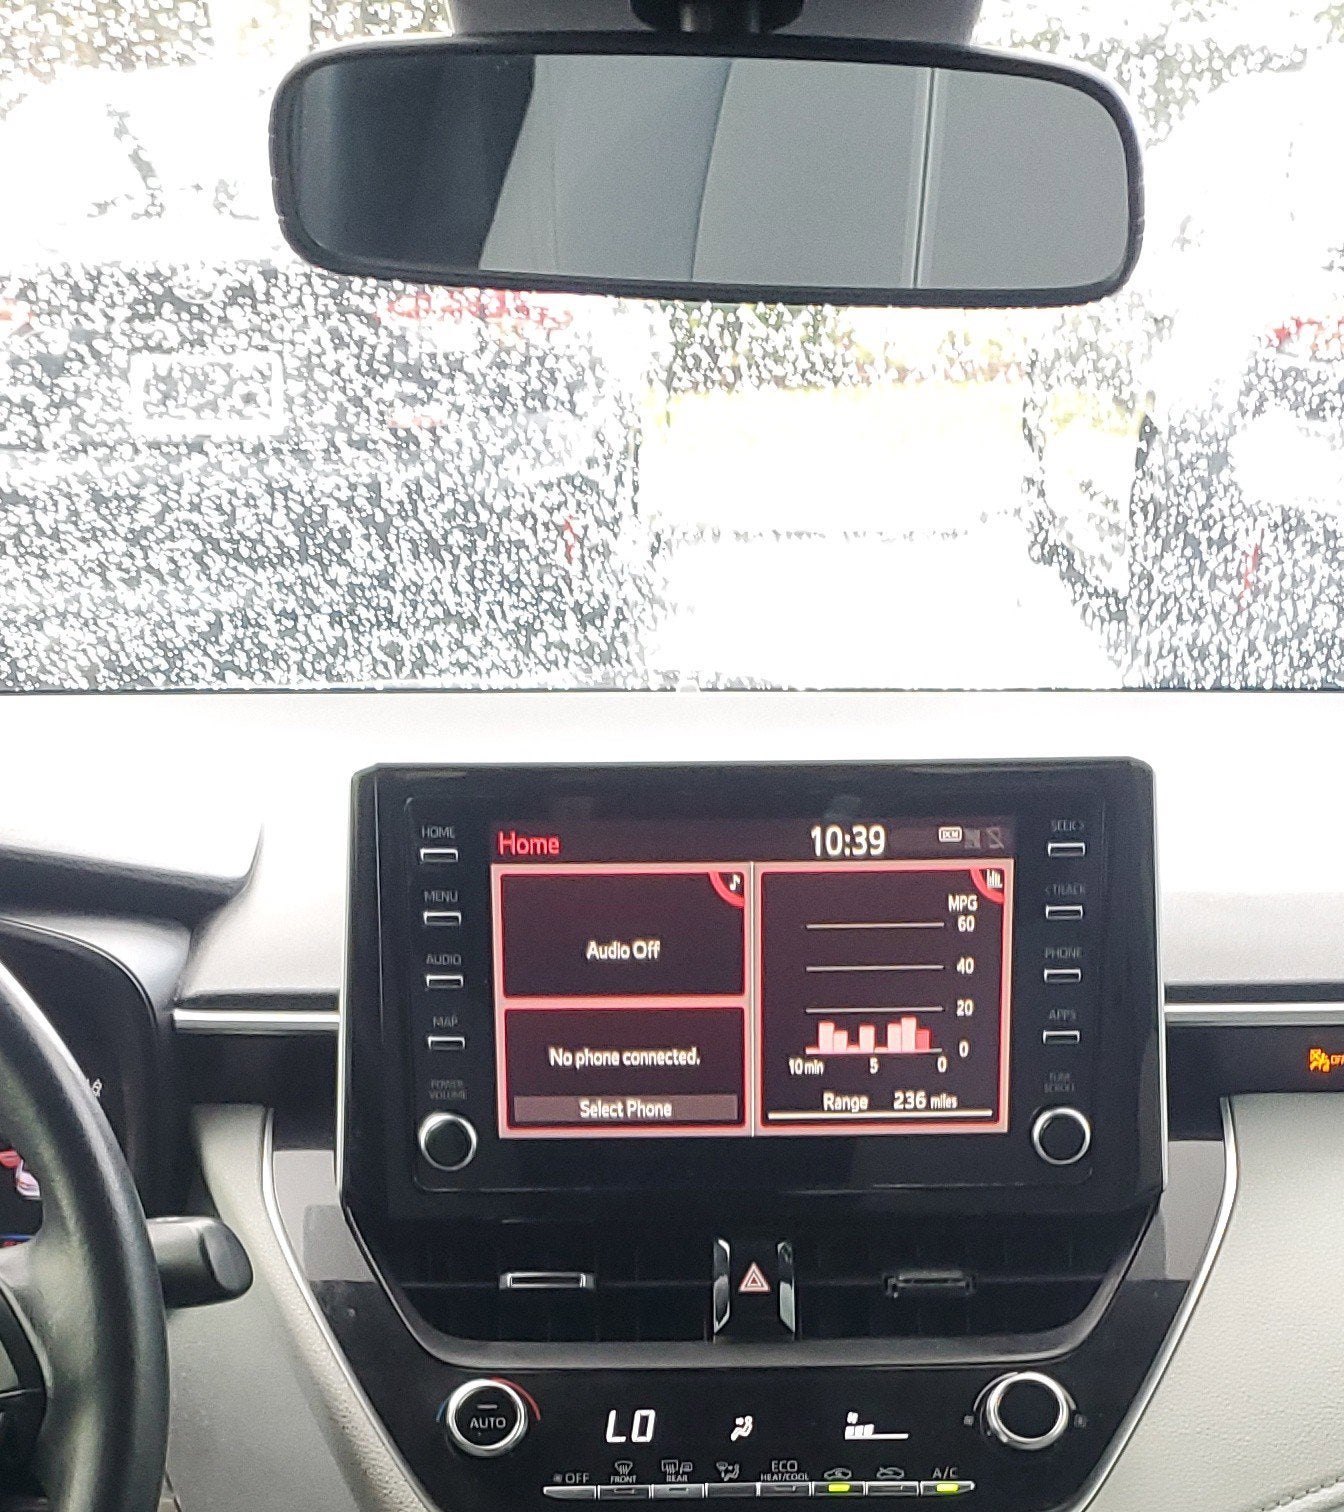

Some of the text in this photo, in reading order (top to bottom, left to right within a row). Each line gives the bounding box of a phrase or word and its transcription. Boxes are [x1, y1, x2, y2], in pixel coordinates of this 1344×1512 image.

[421, 825, 456, 839] HOME
[810, 824, 886, 857] 10:39
[498, 830, 561, 856] Home
[423, 890, 458, 903] MENU
[947, 894, 978, 912] MPG
[957, 915, 976, 933] 60
[586, 939, 661, 960] Audio Off
[425, 953, 462, 966] AUDIO
[956, 956, 975, 975] 40
[955, 999, 974, 1017] 20
[432, 1016, 459, 1028] MAP
[958, 1040, 970, 1058] 0
[548, 1046, 701, 1071] No phone connected.
[788, 1057, 824, 1076] 10 min
[869, 1058, 880, 1075] 5
[936, 1056, 948, 1074] 0
[579, 1098, 673, 1119] Select Phone
[822, 1090, 958, 1113] Range 236 miles
[469, 1416, 507, 1429] AUTO
[605, 1408, 656, 1444] LO
[771, 1459, 798, 1473] ECO
[932, 1466, 959, 1480] A/C
[565, 1472, 590, 1484] OFF
[610, 1474, 637, 1484] FRONT
[666, 1473, 688, 1483] REAR
[760, 1472, 809, 1482] HEAT/COOL
